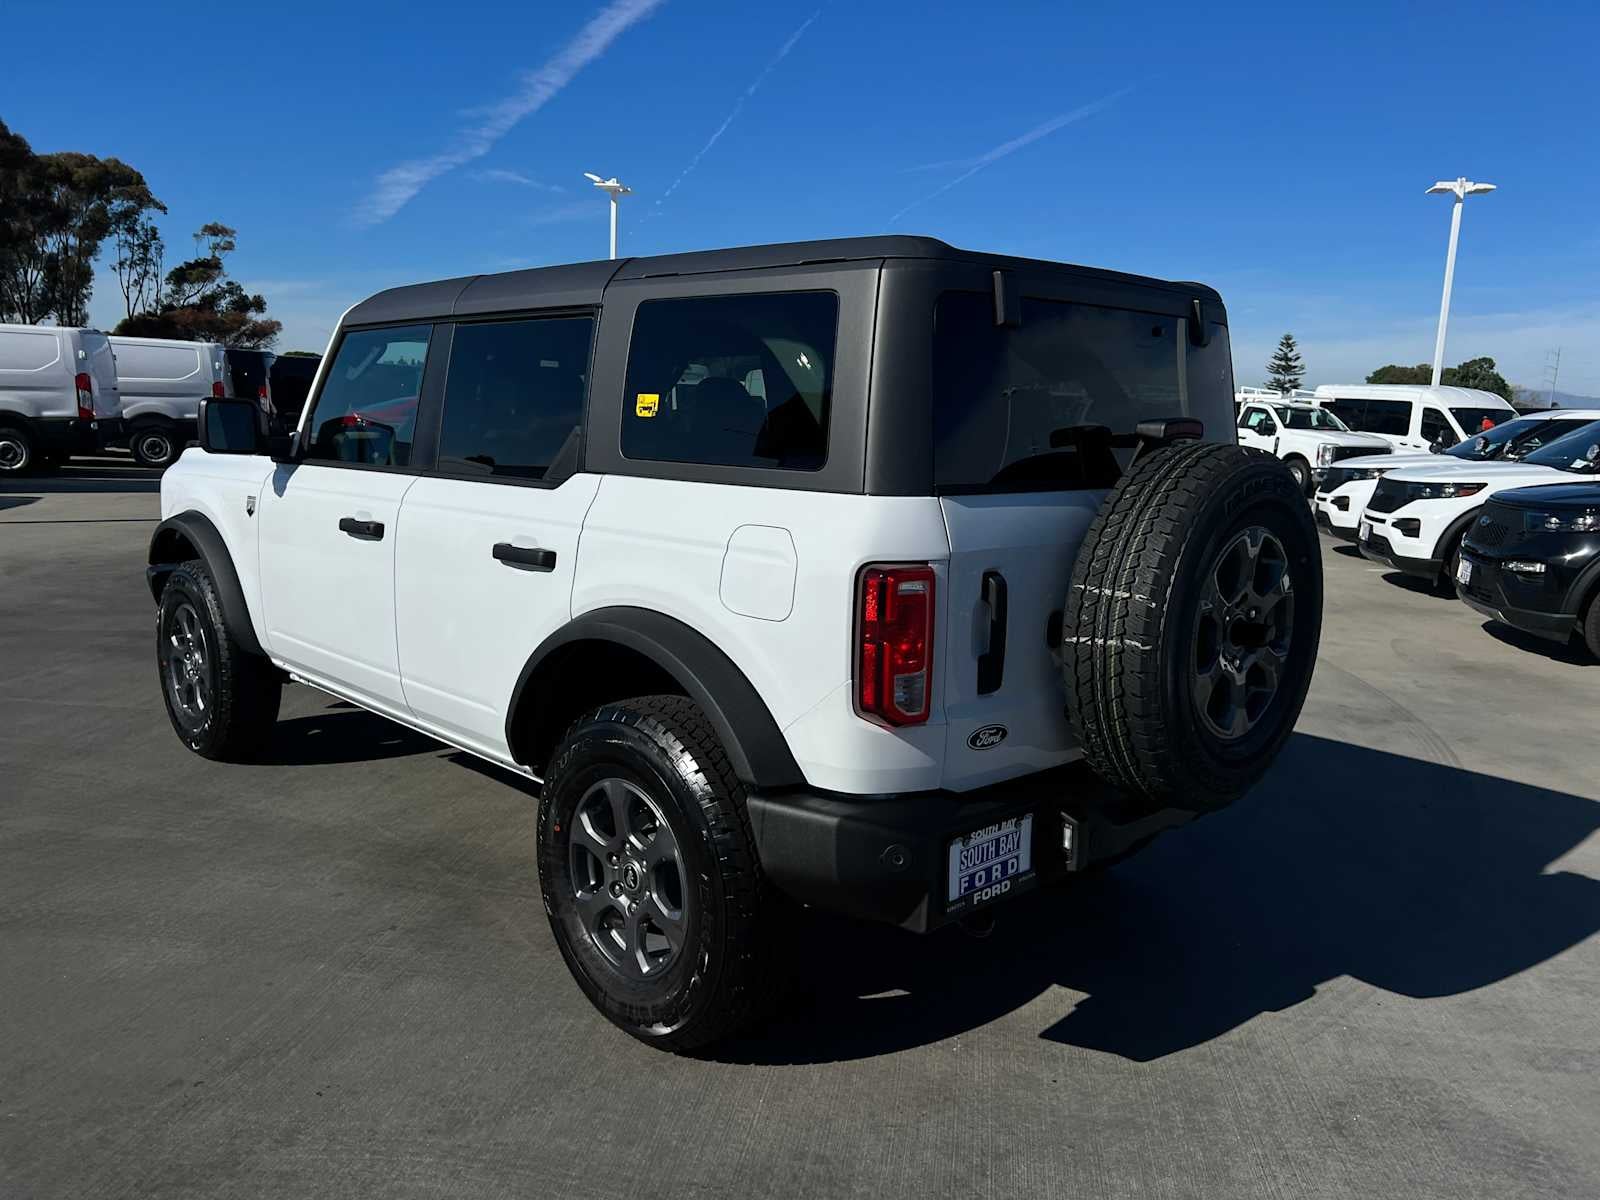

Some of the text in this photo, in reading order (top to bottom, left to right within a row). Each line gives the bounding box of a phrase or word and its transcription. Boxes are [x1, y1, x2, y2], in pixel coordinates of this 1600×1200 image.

[975, 728, 1003, 747] Ford
[961, 831, 1020, 870] SOUTH BAY
[961, 858, 1018, 895] FORD
[974, 880, 1011, 904] FORD
